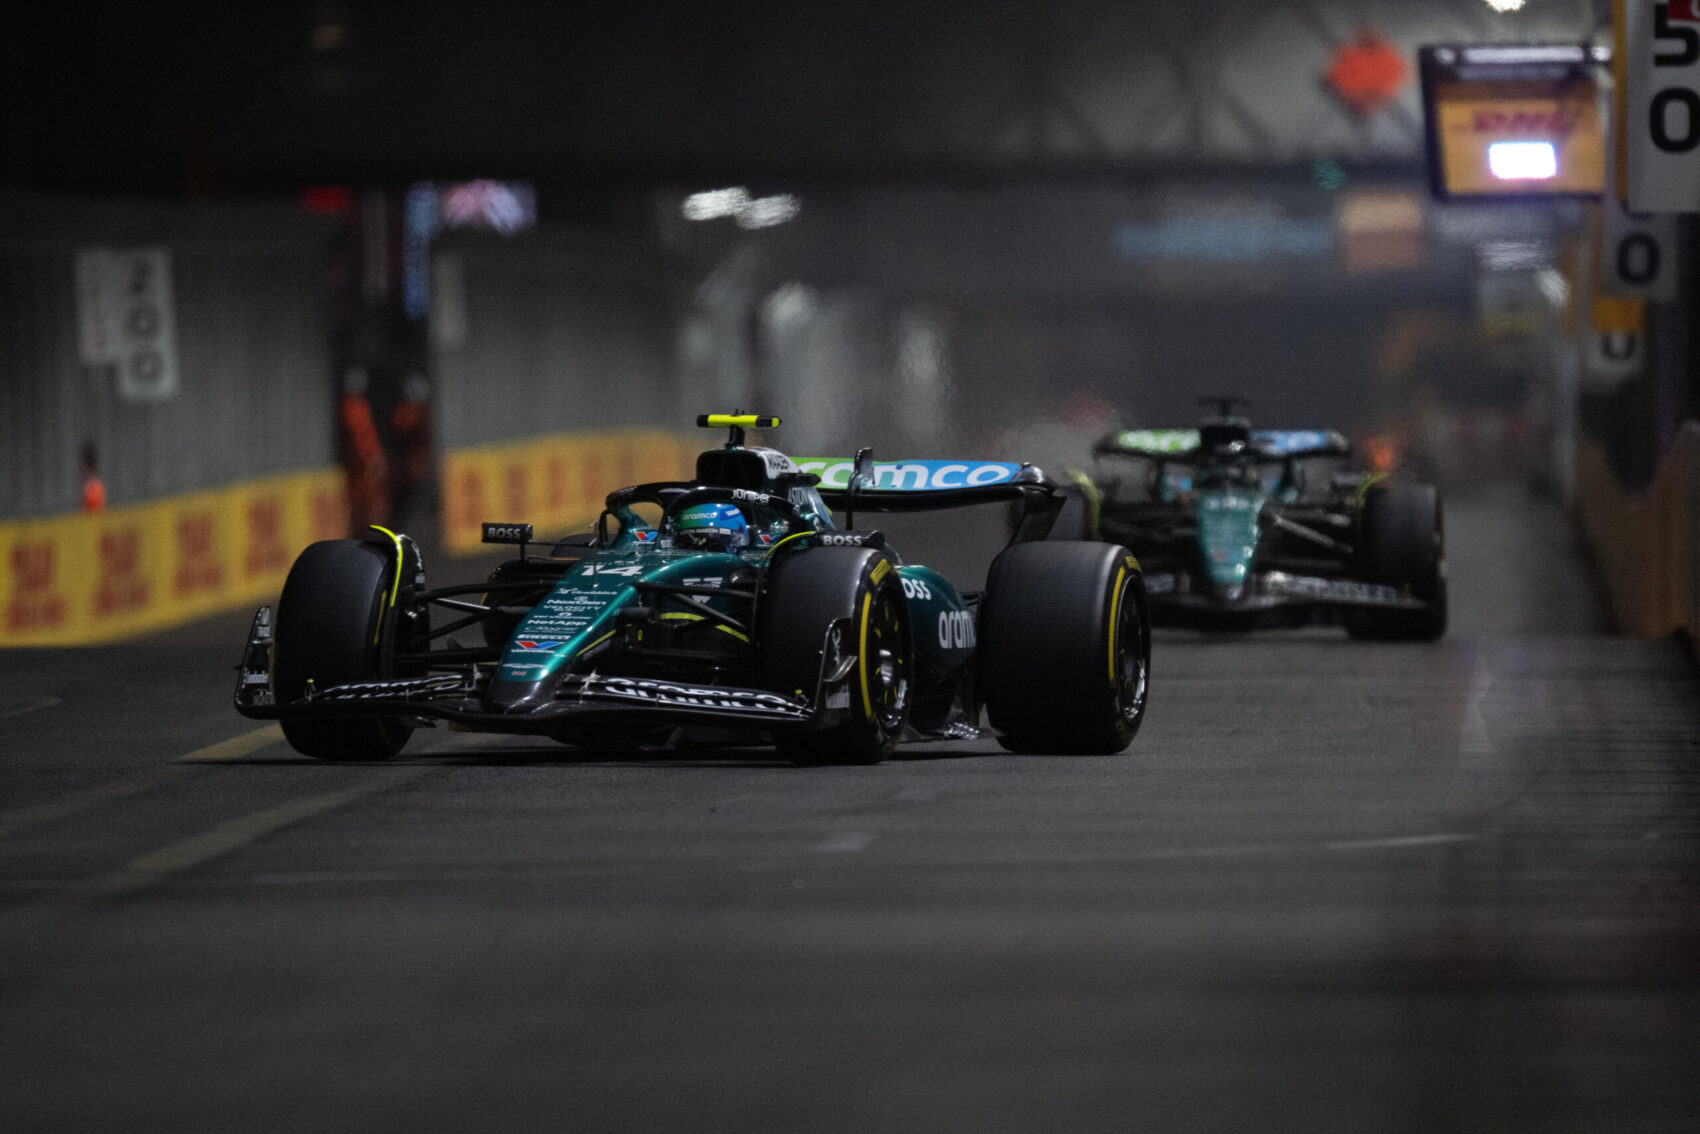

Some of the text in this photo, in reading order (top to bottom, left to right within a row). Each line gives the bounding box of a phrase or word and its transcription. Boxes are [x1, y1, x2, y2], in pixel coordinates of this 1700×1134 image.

[487, 527, 521, 539] BOSS
[823, 535, 863, 546] BOSS
[581, 564, 644, 577] 14
[901, 578, 932, 600] OSS
